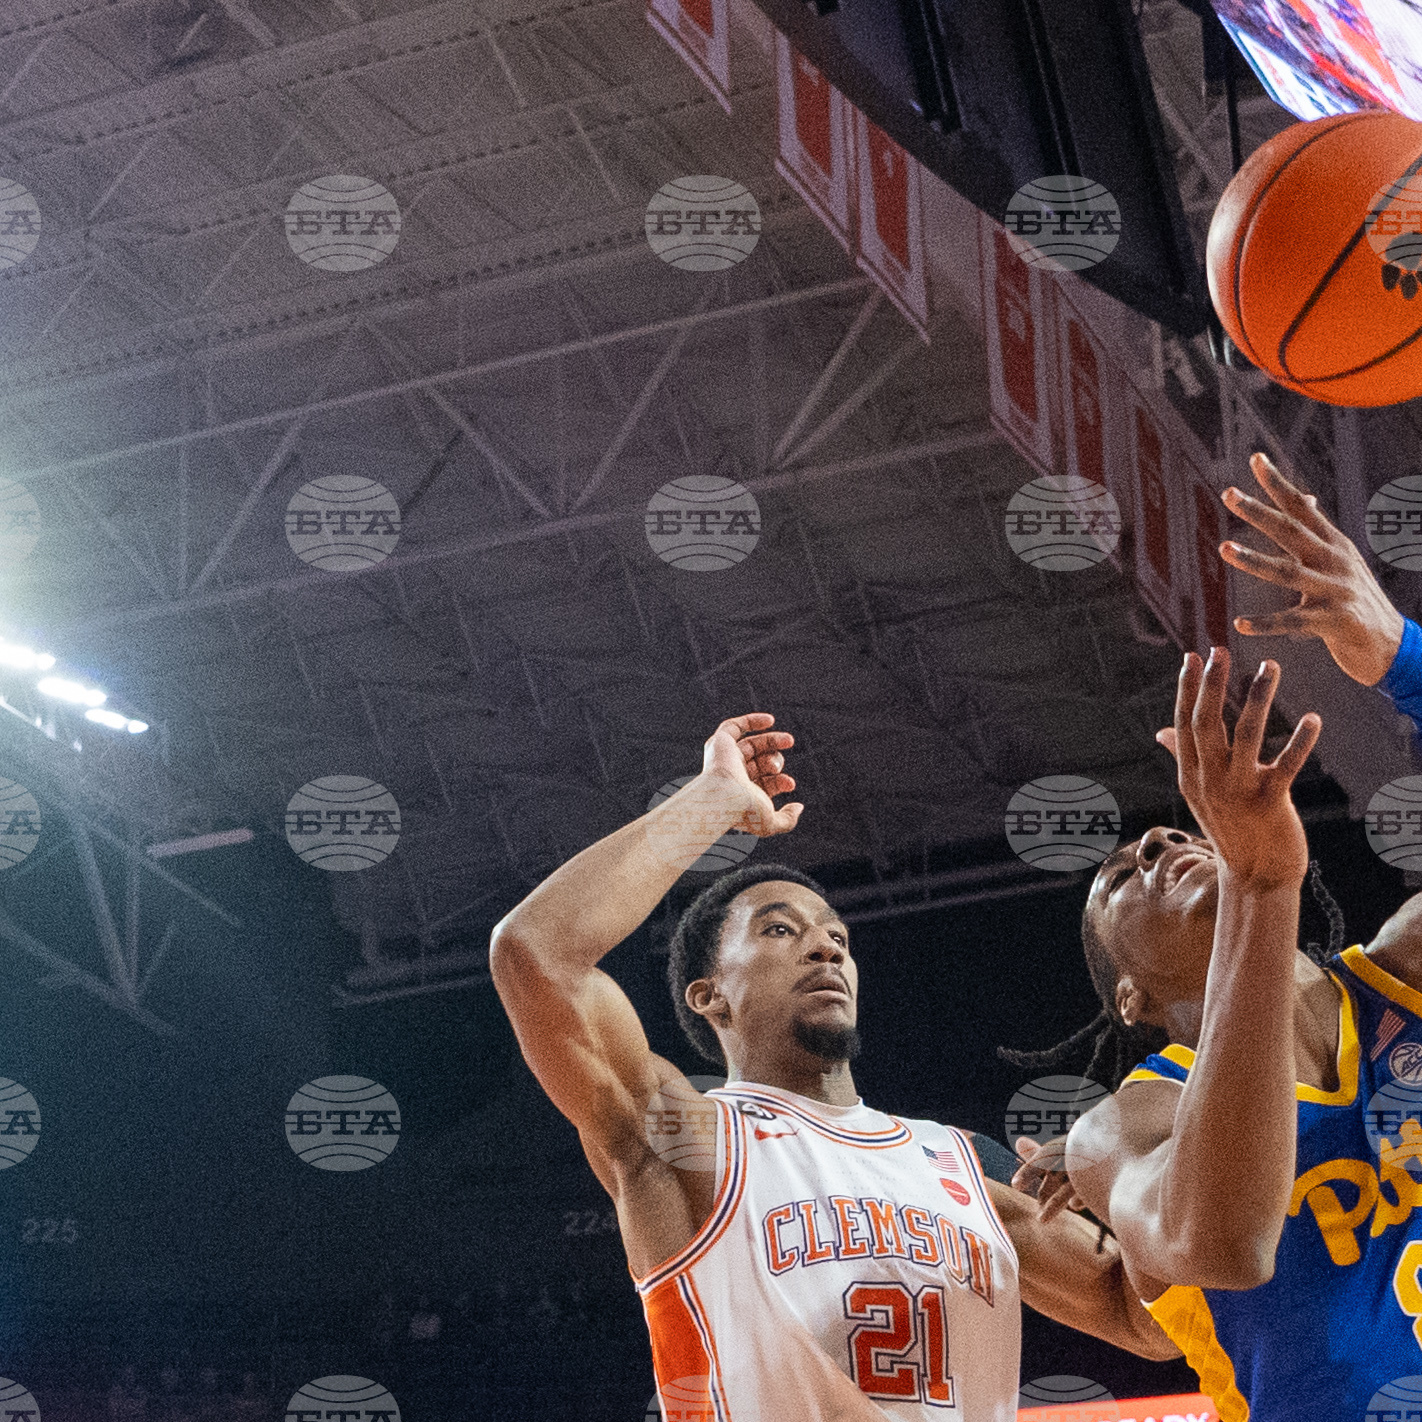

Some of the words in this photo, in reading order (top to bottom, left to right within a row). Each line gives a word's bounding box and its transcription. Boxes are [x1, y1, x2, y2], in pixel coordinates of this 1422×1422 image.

[22, 1218, 78, 1246] 225
[762, 1194, 996, 1308] CLEMSON
[842, 1281, 956, 1409] 21
